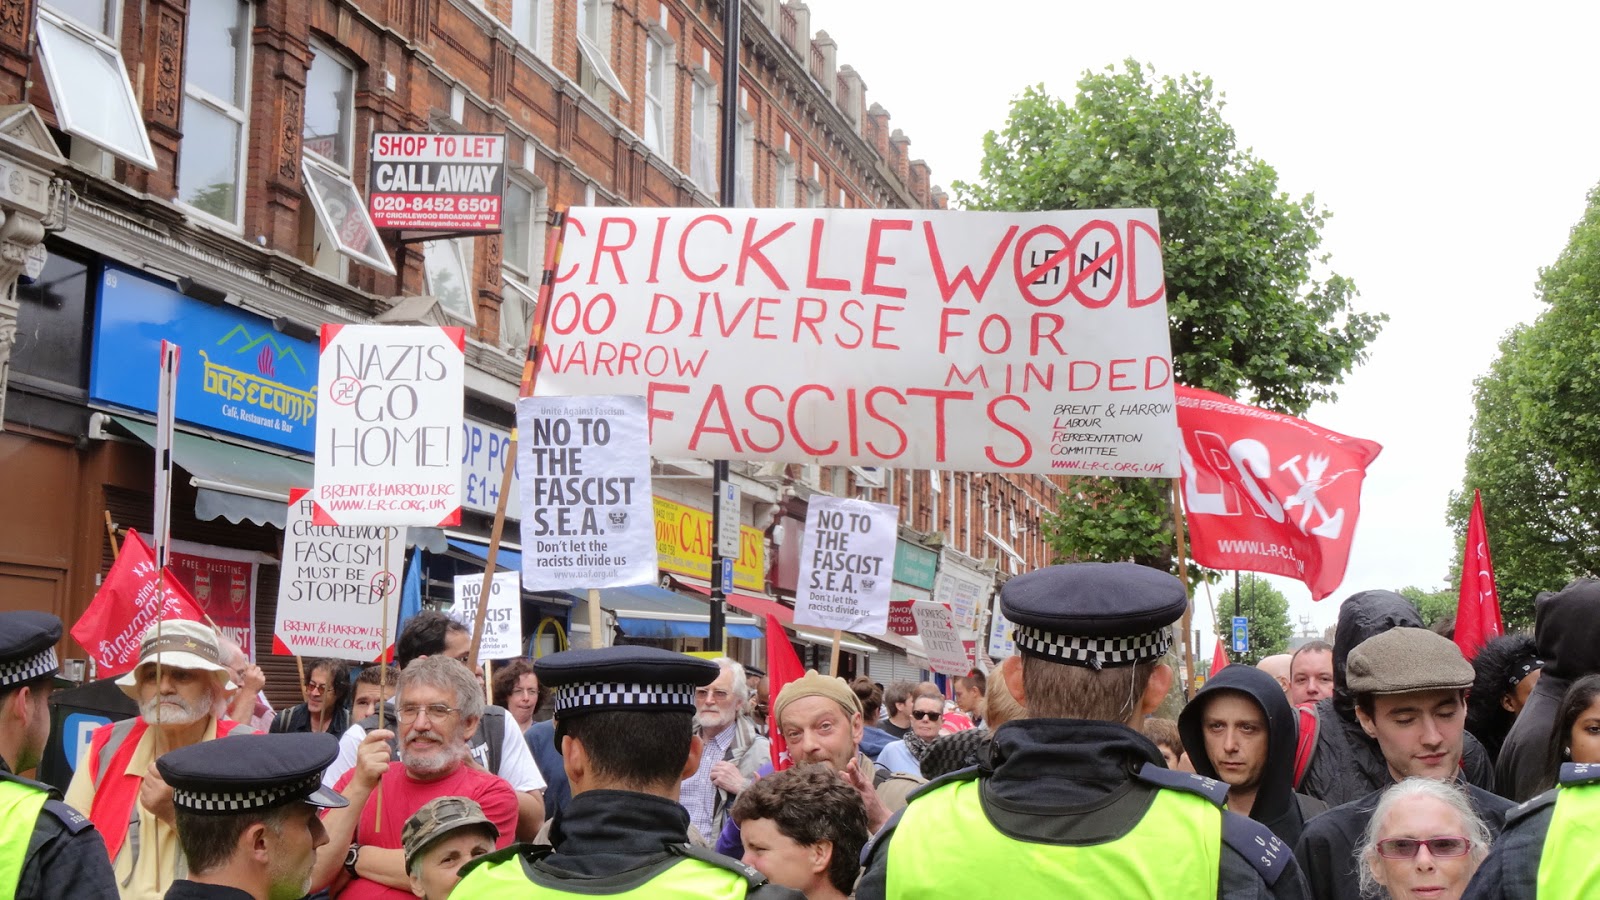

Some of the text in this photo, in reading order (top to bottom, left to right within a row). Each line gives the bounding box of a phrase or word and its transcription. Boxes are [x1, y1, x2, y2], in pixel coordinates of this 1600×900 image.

[379, 136, 496, 158] SHOP TO LET
[376, 164, 498, 192] CALLAWAY
[373, 196, 498, 212] 020-8452 6501
[386, 212, 438, 220] CRICKLEWOOD
[387, 220, 482, 228] www.callawayandco.co.uk
[554, 214, 1165, 309] CRICKLEWOOD
[105, 273, 117, 288] 89
[551, 291, 1068, 356] OO DIVERSE FOR
[336, 343, 447, 381] NAZIS
[538, 341, 1171, 394] NARROW MINDED
[199, 350, 318, 426] basecamp
[354, 384, 418, 422] GO
[540, 407, 625, 417] Unite Against Fascism
[1053, 403, 1172, 418] BRENT & HARROW
[240, 408, 274, 429] Restaurant
[274, 418, 280, 430] &
[281, 420, 294, 434] Bar
[533, 418, 611, 446] NO TO
[647, 381, 1033, 468] FASCISTS
[331, 426, 450, 467] HOME!
[532, 447, 583, 476] THE
[1051, 460, 1165, 473] WWW.L-R-C.ORG.UK
[1178, 427, 1285, 523] LRC
[431, 483, 455, 496] LRC
[467, 473, 499, 506] £1+
[534, 476, 635, 506] FASCIST
[330, 499, 447, 512] WWW.L-R-C.ORG.UK
[534, 507, 605, 536] S.E.A.
[817, 510, 872, 534] NO TO
[656, 520, 678, 546] OWN
[815, 530, 849, 552] THE
[294, 541, 382, 566] FASCISM
[536, 540, 608, 553] Don't let the
[182, 559, 199, 570] FREE
[206, 563, 242, 575] PALESTINE
[537, 553, 627, 568] racists divide us
[812, 549, 883, 576] FASCIST
[298, 566, 366, 580] MUST BE
[553, 569, 619, 580] www.uaf.org.uk
[809, 570, 858, 594] S.E.A.
[287, 580, 385, 605] STOPPED
[462, 583, 481, 596] NO
[809, 592, 858, 606] Don't let the
[462, 597, 479, 610] TH
[808, 603, 870, 617] racists divide us
[462, 608, 513, 623] FACIST
[932, 621, 944, 629] ALL
[283, 619, 317, 633] BRENT
[318, 621, 326, 633] &
[328, 623, 370, 636] HARROW
[1254, 835, 1266, 847] U
[1261, 836, 1283, 867] 3142
